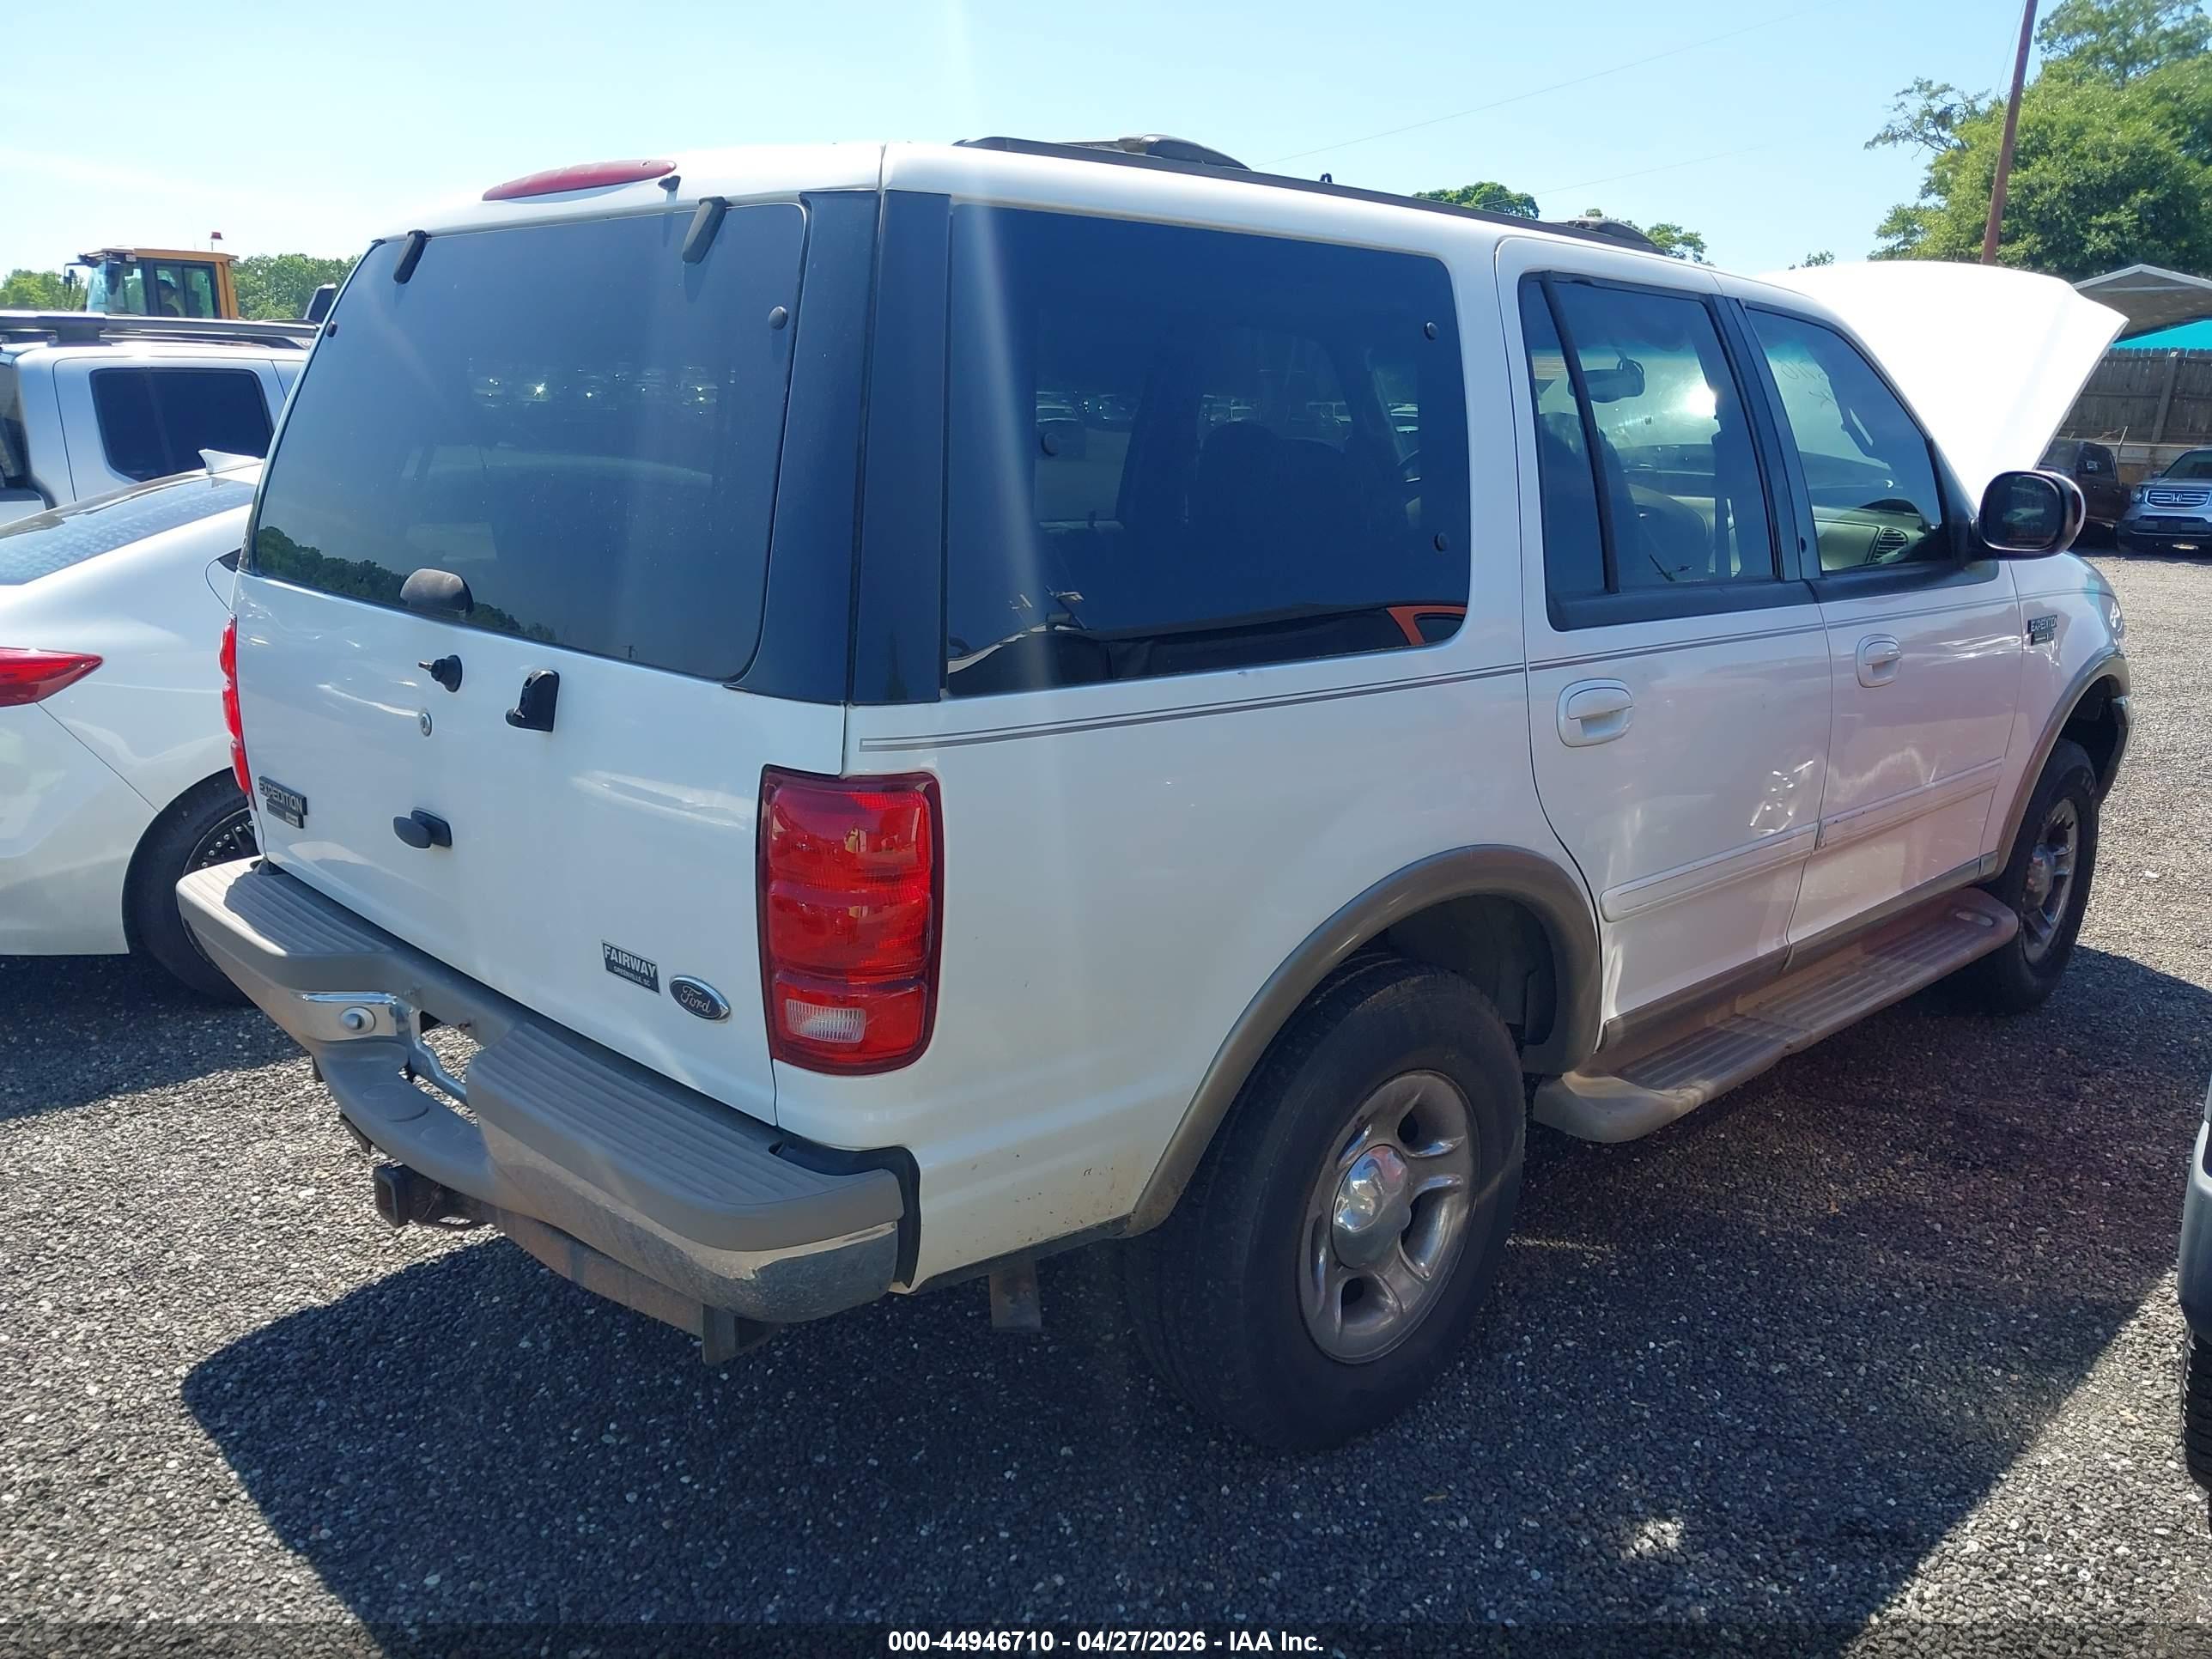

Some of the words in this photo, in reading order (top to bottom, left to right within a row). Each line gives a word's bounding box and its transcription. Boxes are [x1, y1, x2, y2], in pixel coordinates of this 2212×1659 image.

[259, 782, 302, 812] EXPEDITION
[604, 945, 656, 978] FAIRWAY
[680, 985, 711, 1013] Ford
